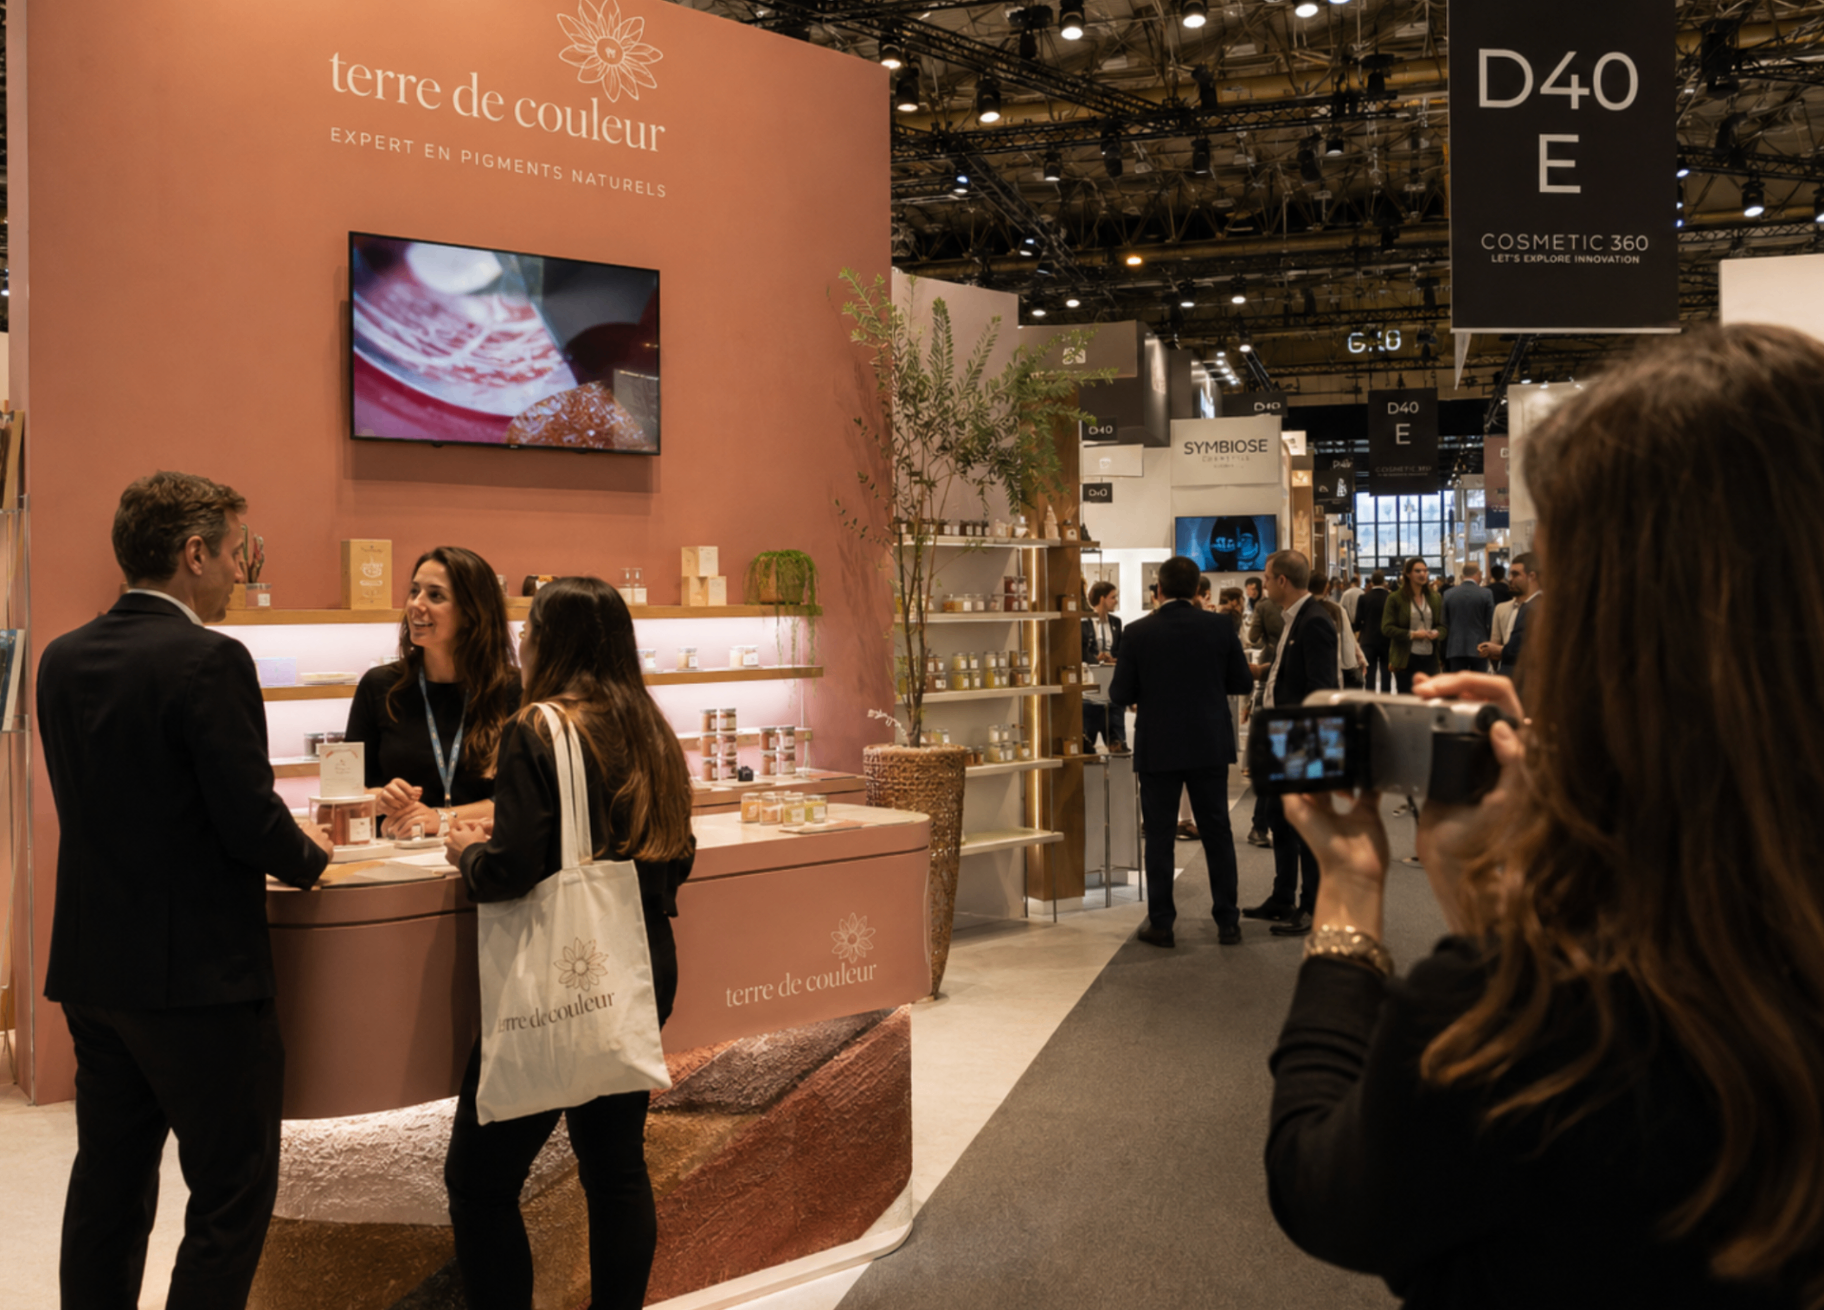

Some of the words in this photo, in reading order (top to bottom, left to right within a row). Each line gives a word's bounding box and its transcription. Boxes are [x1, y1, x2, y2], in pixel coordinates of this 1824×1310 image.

[1478, 48, 1639, 111] D40
[329, 52, 441, 110] terre
[452, 72, 504, 121] de
[514, 97, 666, 152] couleur
[330, 127, 414, 154] EXPERT
[424, 143, 450, 160] EN
[461, 150, 563, 180] PIGMENTS
[572, 170, 667, 198] NATURELS
[1539, 133, 1581, 194] E
[1481, 233, 1604, 250] COSMETIC
[1610, 234, 1649, 251] 360
[1491, 254, 1521, 263] LET'S
[1523, 254, 1571, 264] EXPLORE
[1574, 254, 1640, 264] INNOVATION
[1387, 401, 1419, 415] D40
[1184, 438, 1269, 455] SYMBIOSE
[1396, 423, 1411, 445] E
[725, 987, 774, 1008] terre
[778, 972, 802, 997] de
[805, 962, 877, 992] couleur
[548, 993, 615, 1024] couleur
